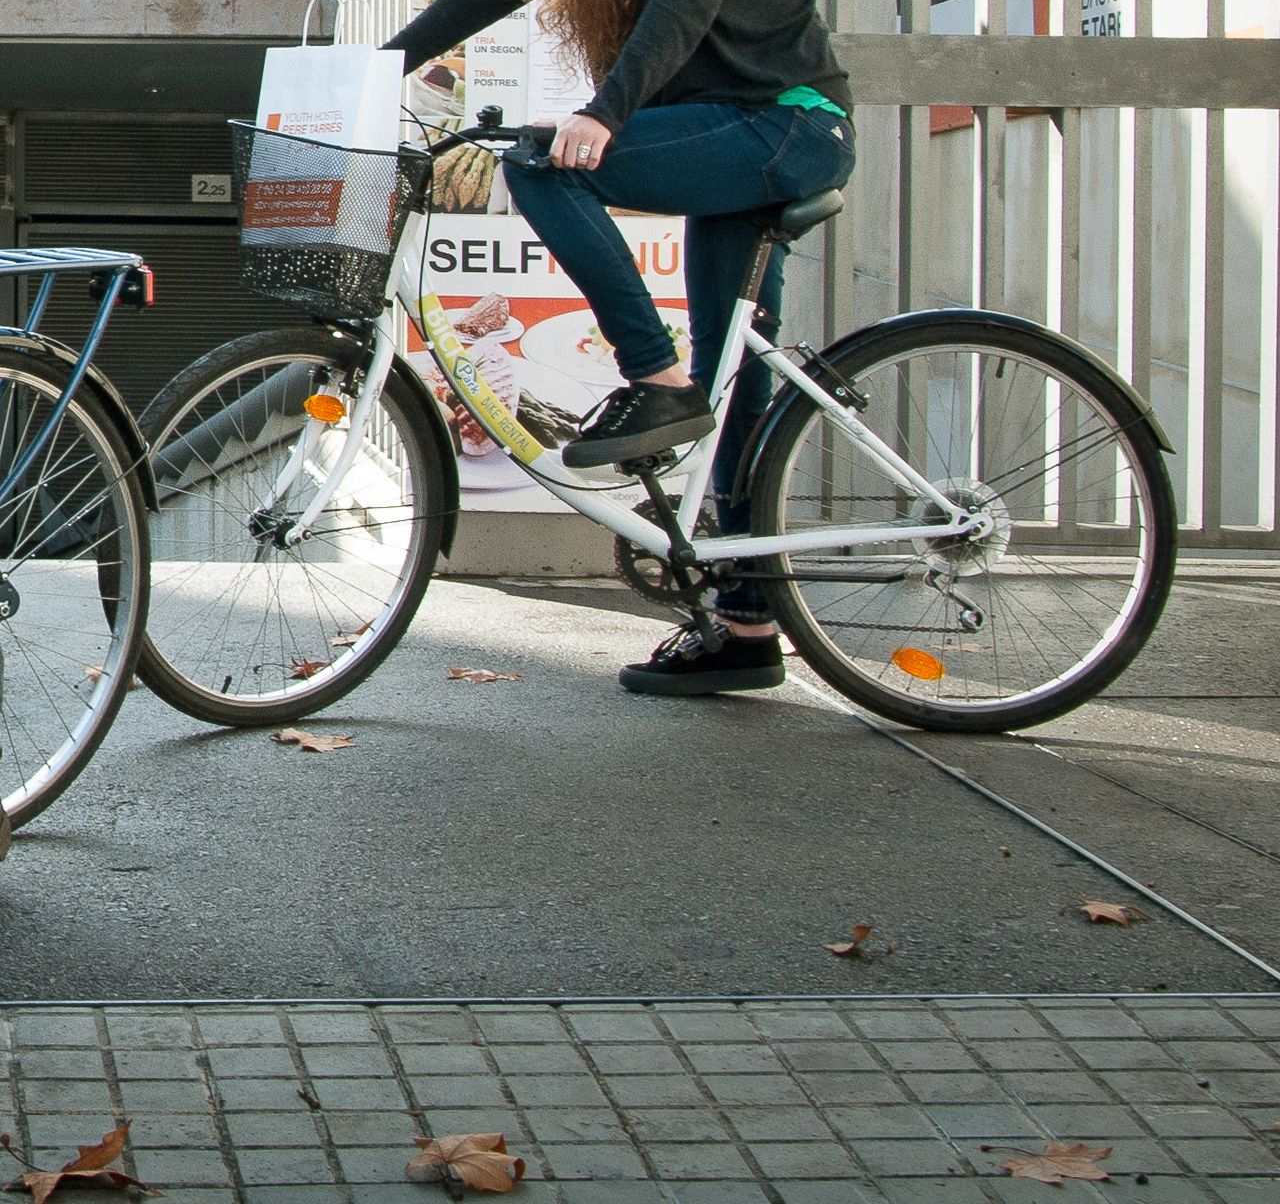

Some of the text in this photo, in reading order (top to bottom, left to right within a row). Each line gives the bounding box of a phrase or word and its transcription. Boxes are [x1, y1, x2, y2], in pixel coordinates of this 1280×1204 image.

[474, 36, 496, 45] TRIA
[474, 69, 496, 78] TRIA
[282, 124, 307, 134] PERE
[481, 398, 500, 419] BIKE
[498, 418, 529, 452] RENTAL
